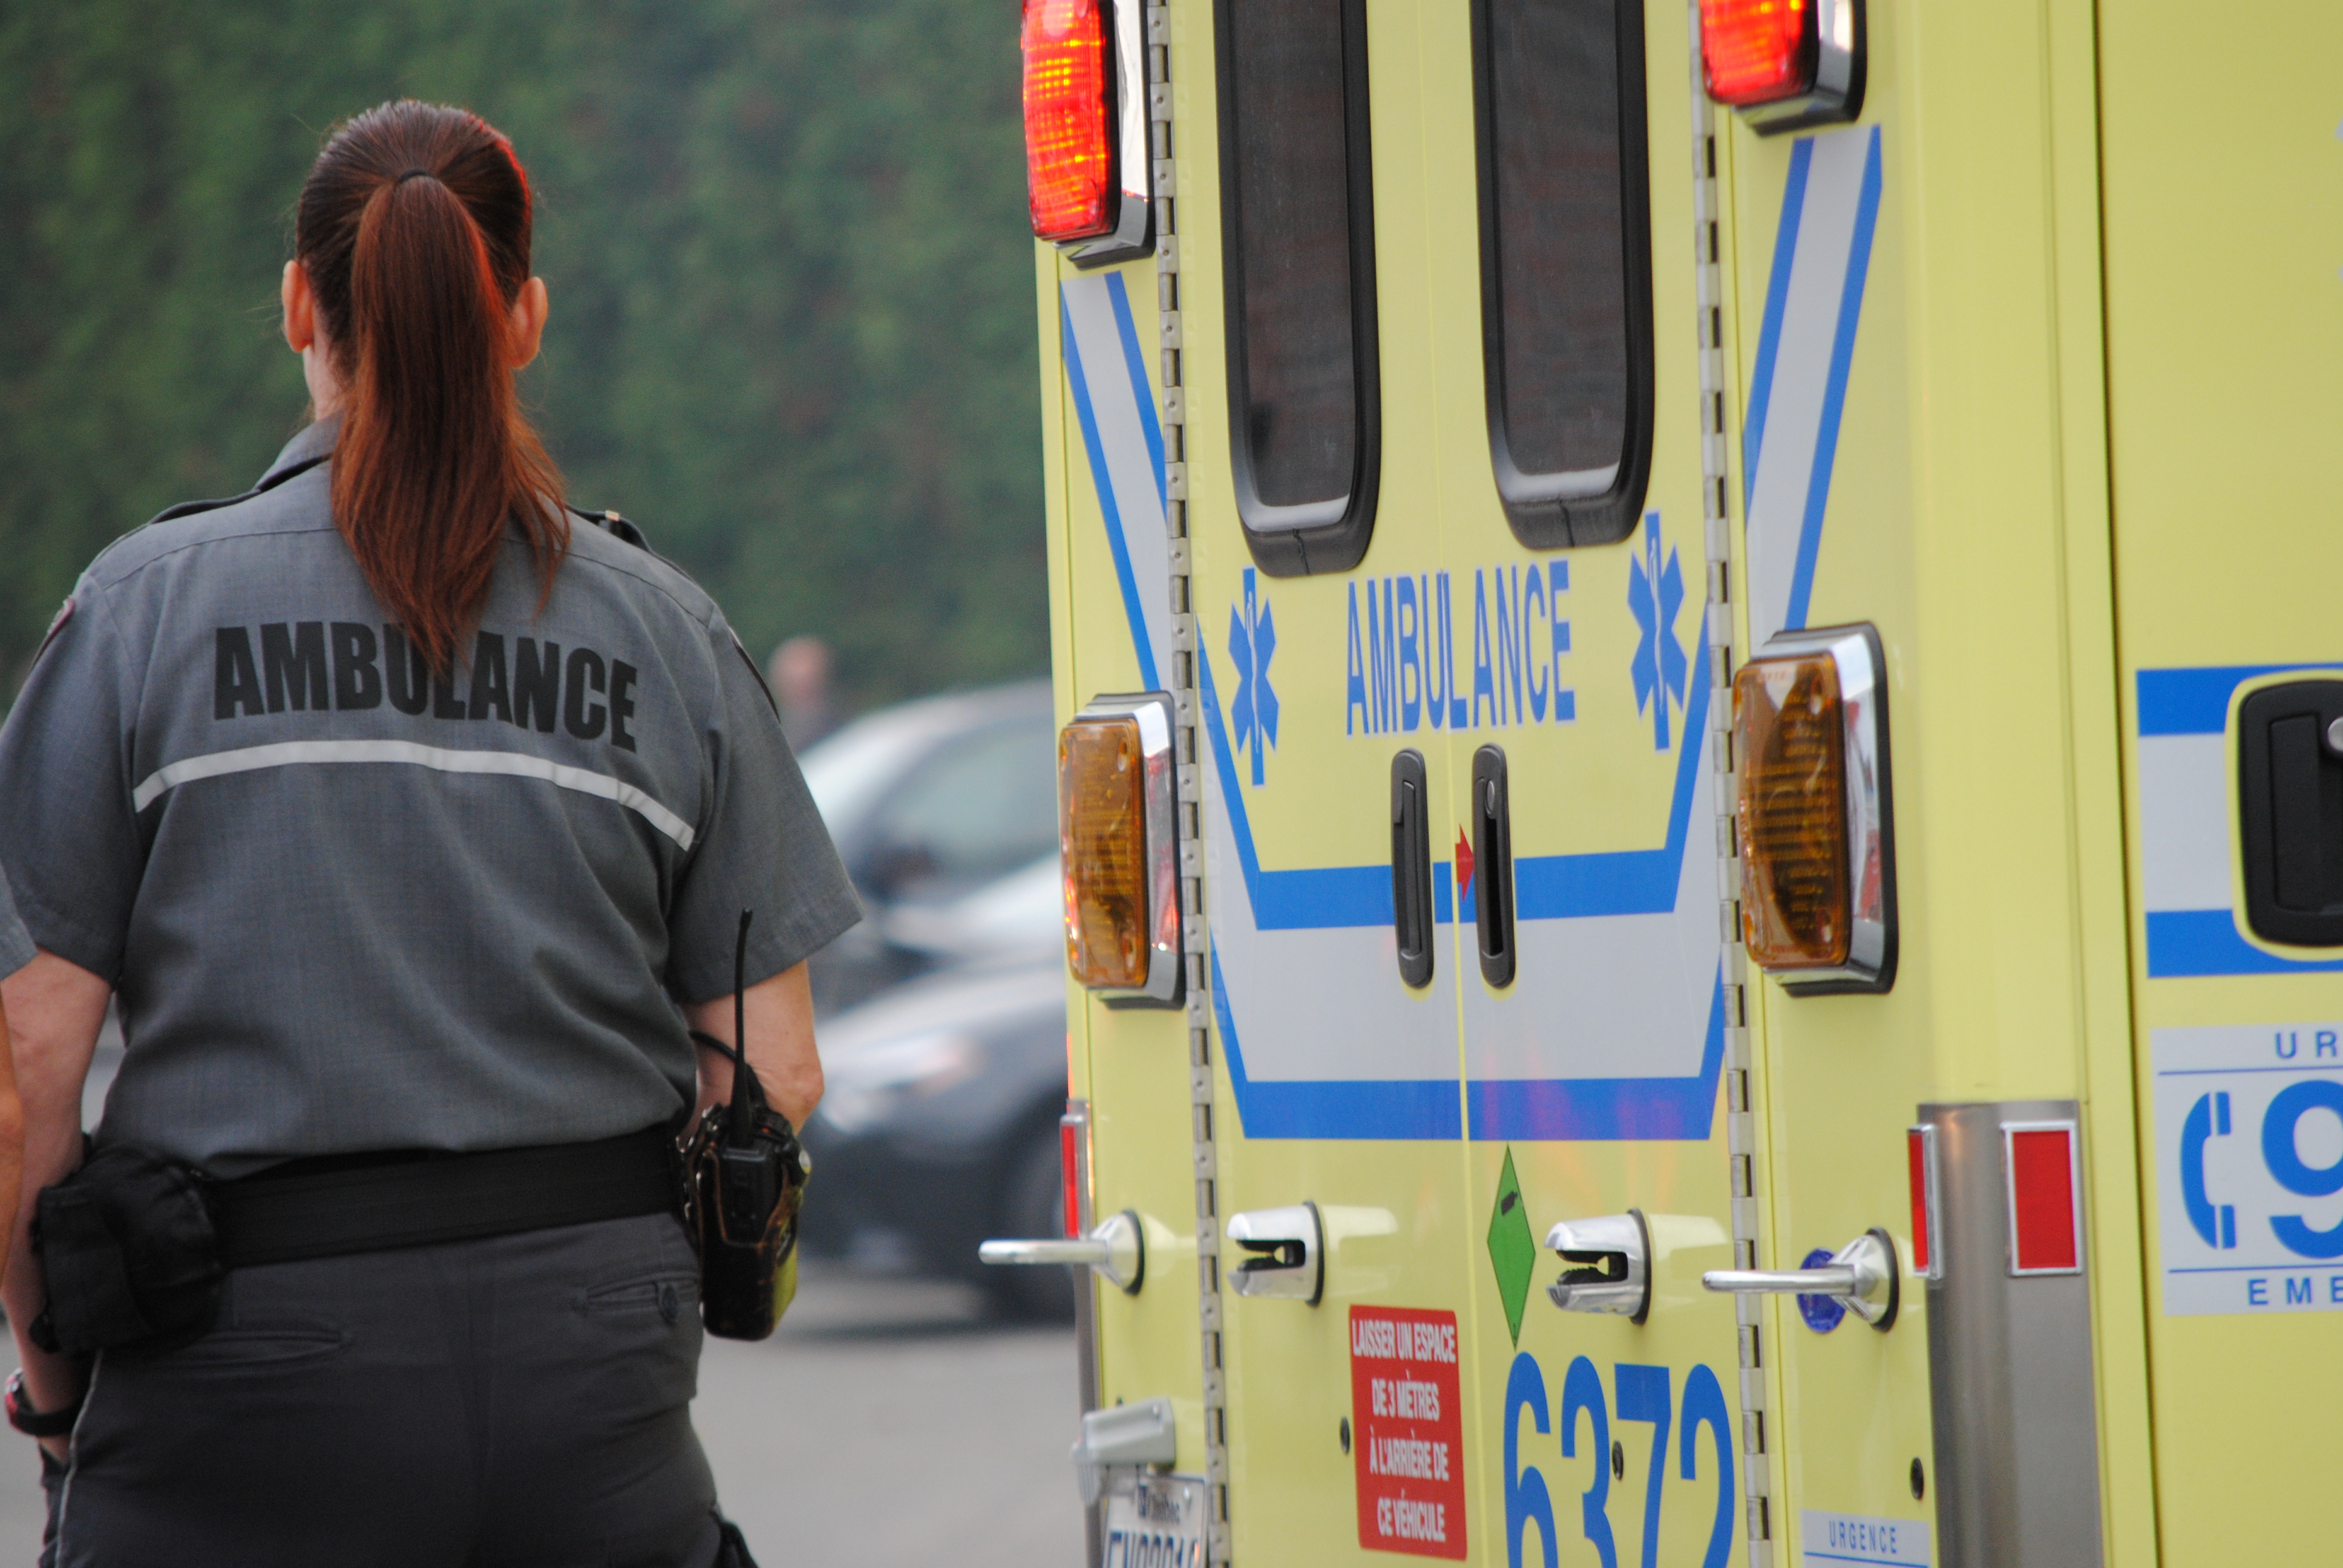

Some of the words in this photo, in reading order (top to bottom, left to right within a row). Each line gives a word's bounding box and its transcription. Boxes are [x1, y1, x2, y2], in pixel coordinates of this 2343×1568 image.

[1346, 556, 1576, 738] AMBULANCE
[1351, 1319, 1395, 1359] LAISSER
[1396, 1321, 1413, 1360] UN
[1414, 1322, 1456, 1364] ESPACE
[1371, 1377, 1388, 1417] DE
[1388, 1380, 1395, 1417] 3
[1395, 1368, 1440, 1422] MÈTRES
[1432, 1442, 1449, 1481] DE
[1504, 1351, 1735, 1568] 6372
[1377, 1496, 1394, 1537] CE
[1392, 1487, 1446, 1543] VÉHICULE
[1829, 1520, 1897, 1555] URGENCE
